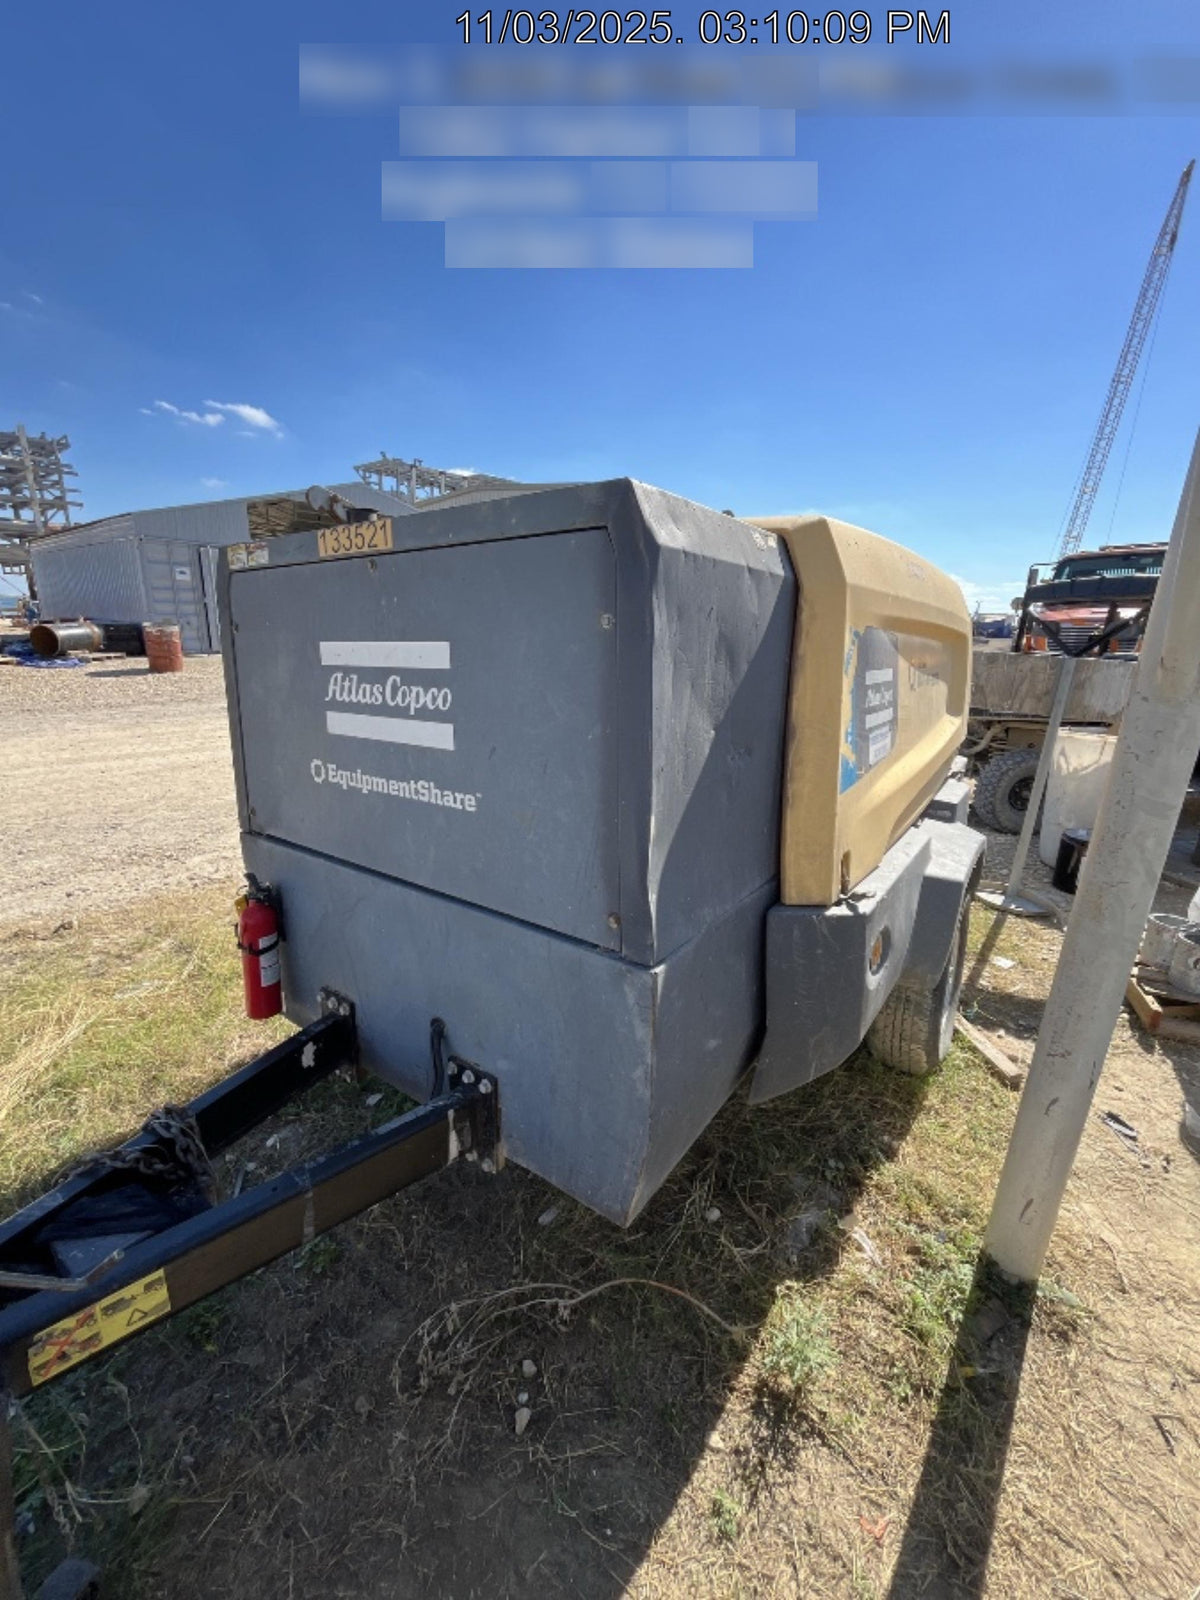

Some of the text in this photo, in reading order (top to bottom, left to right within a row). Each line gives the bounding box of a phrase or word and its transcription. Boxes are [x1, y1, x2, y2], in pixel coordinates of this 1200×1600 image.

[319, 519, 388, 554] 133521
[325, 672, 452, 715] Atlas Copco
[327, 763, 477, 812] EquipmentShare
